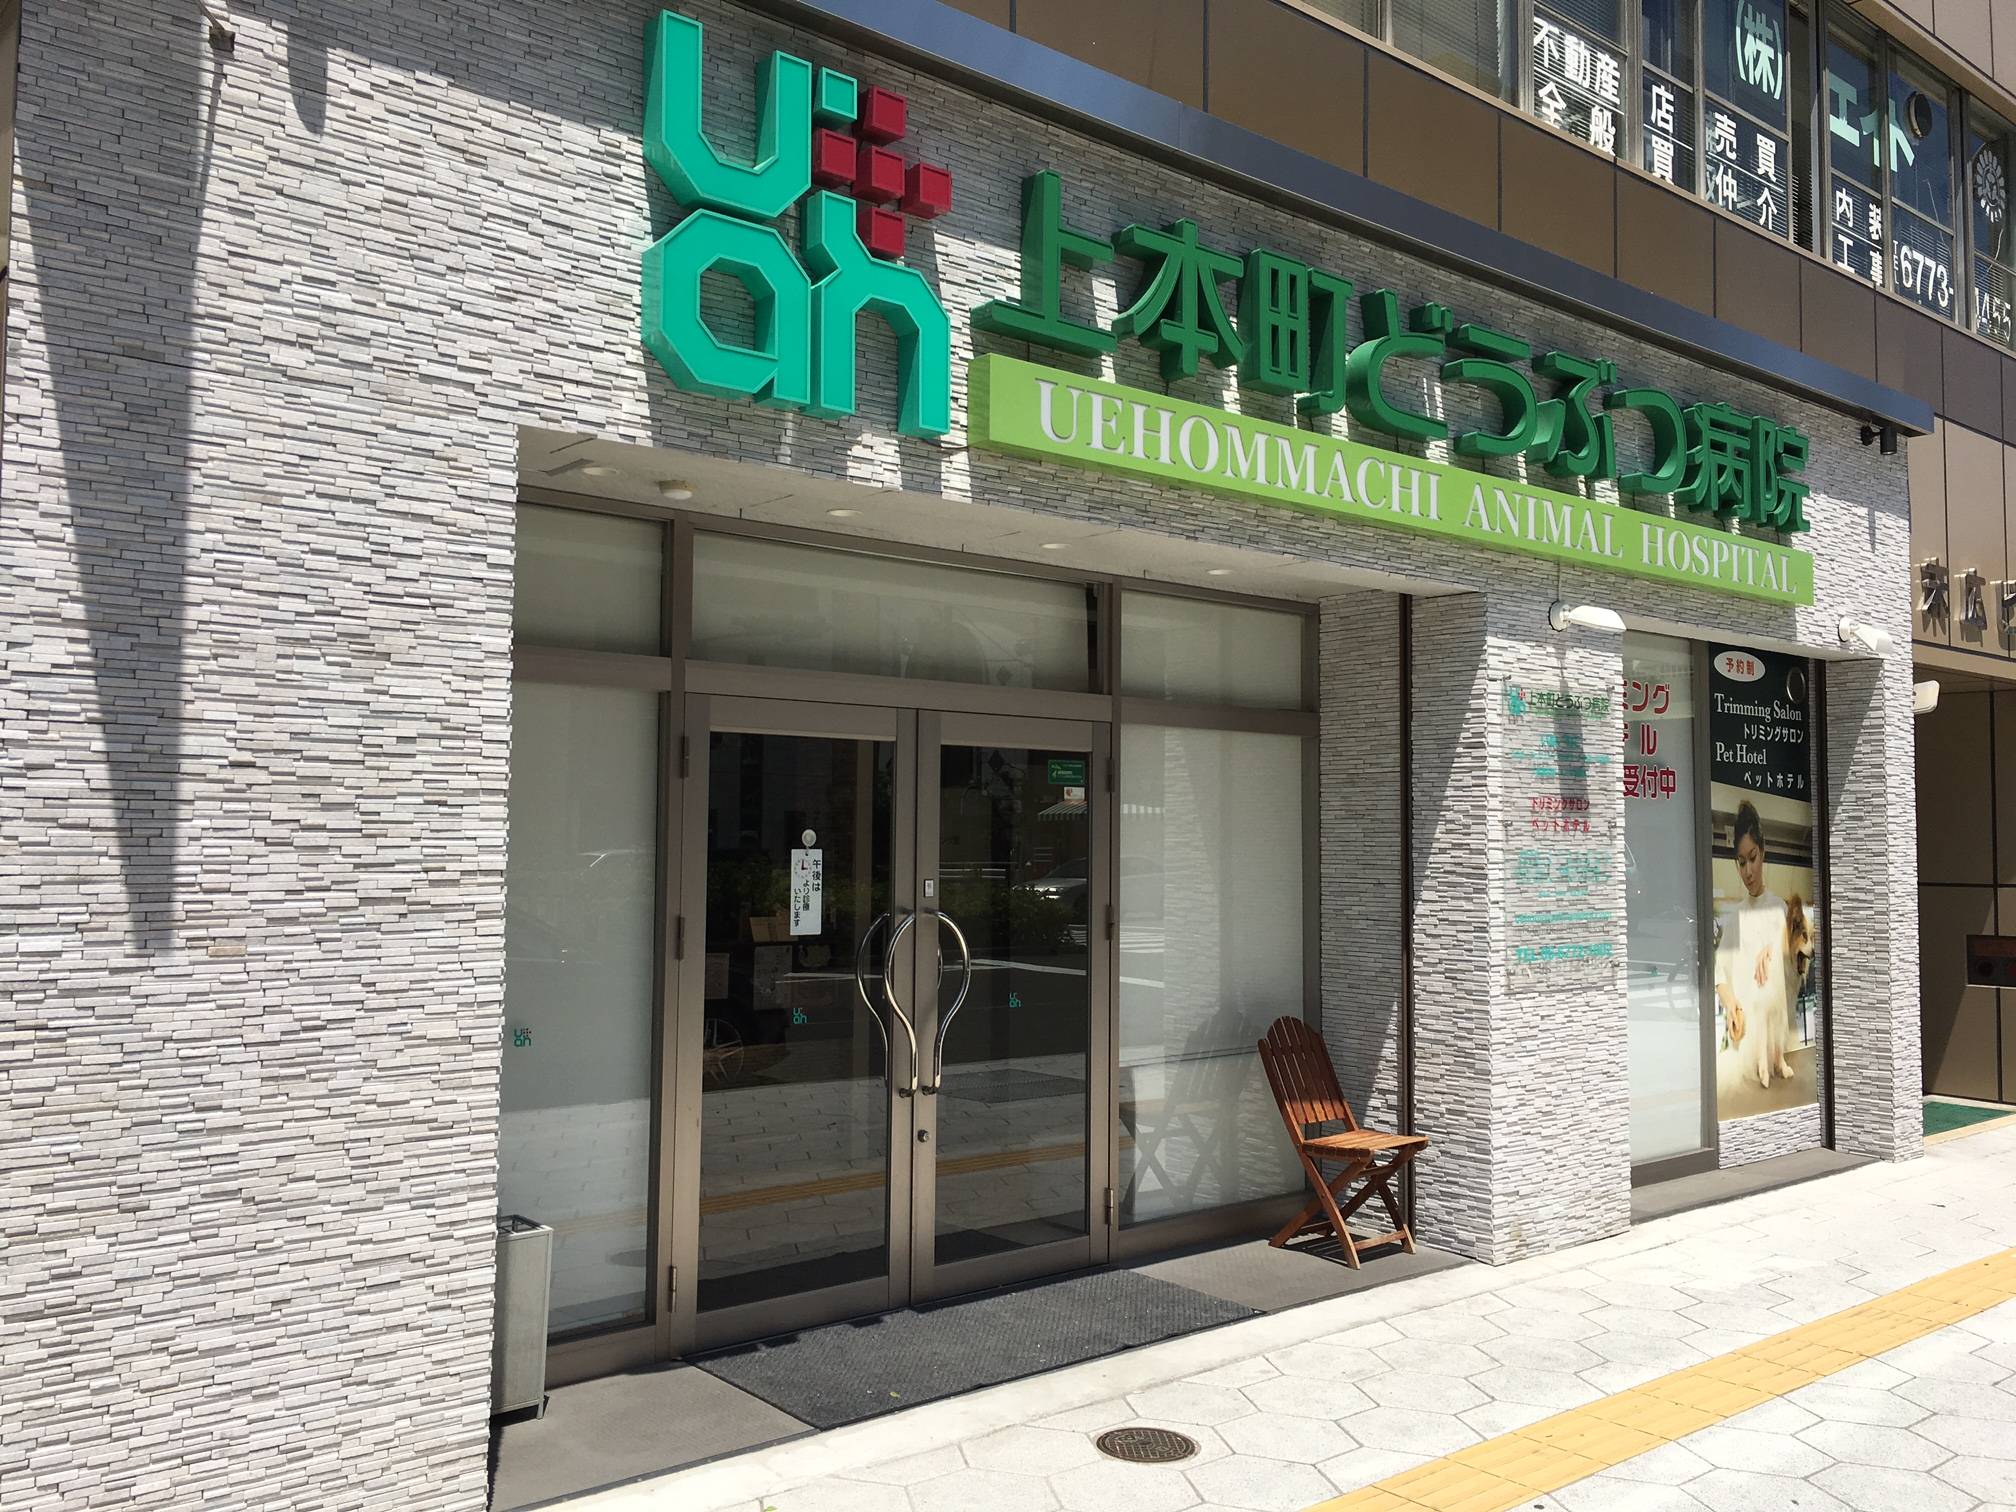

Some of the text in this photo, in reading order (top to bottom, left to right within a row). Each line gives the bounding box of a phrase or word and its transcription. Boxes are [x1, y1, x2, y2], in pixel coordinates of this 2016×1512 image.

[1533, 17, 1621, 105] 不動産
[1538, 81, 1616, 156] 全般
[1714, 112, 1777, 183] 売買
[1716, 163, 1777, 230] 仲介
[1835, 188, 1882, 241] 内装
[1837, 233, 1883, 287] 工事
[1892, 239, 1901, 285] TEL
[971, 168, 1810, 535] 上本町どうぶつ病院
[1035, 377, 1798, 595] UEHOMMACHI ANIMAL HOSPITAL
[1714, 693, 1801, 722] Trimming Salon
[1744, 723, 1804, 743] トリミングサロン
[1715, 742, 1767, 765] Pet Hotel
[1623, 764, 1677, 799] 受付中
[812, 859, 822, 892] 午後は
[793, 888, 802, 927] いたします
